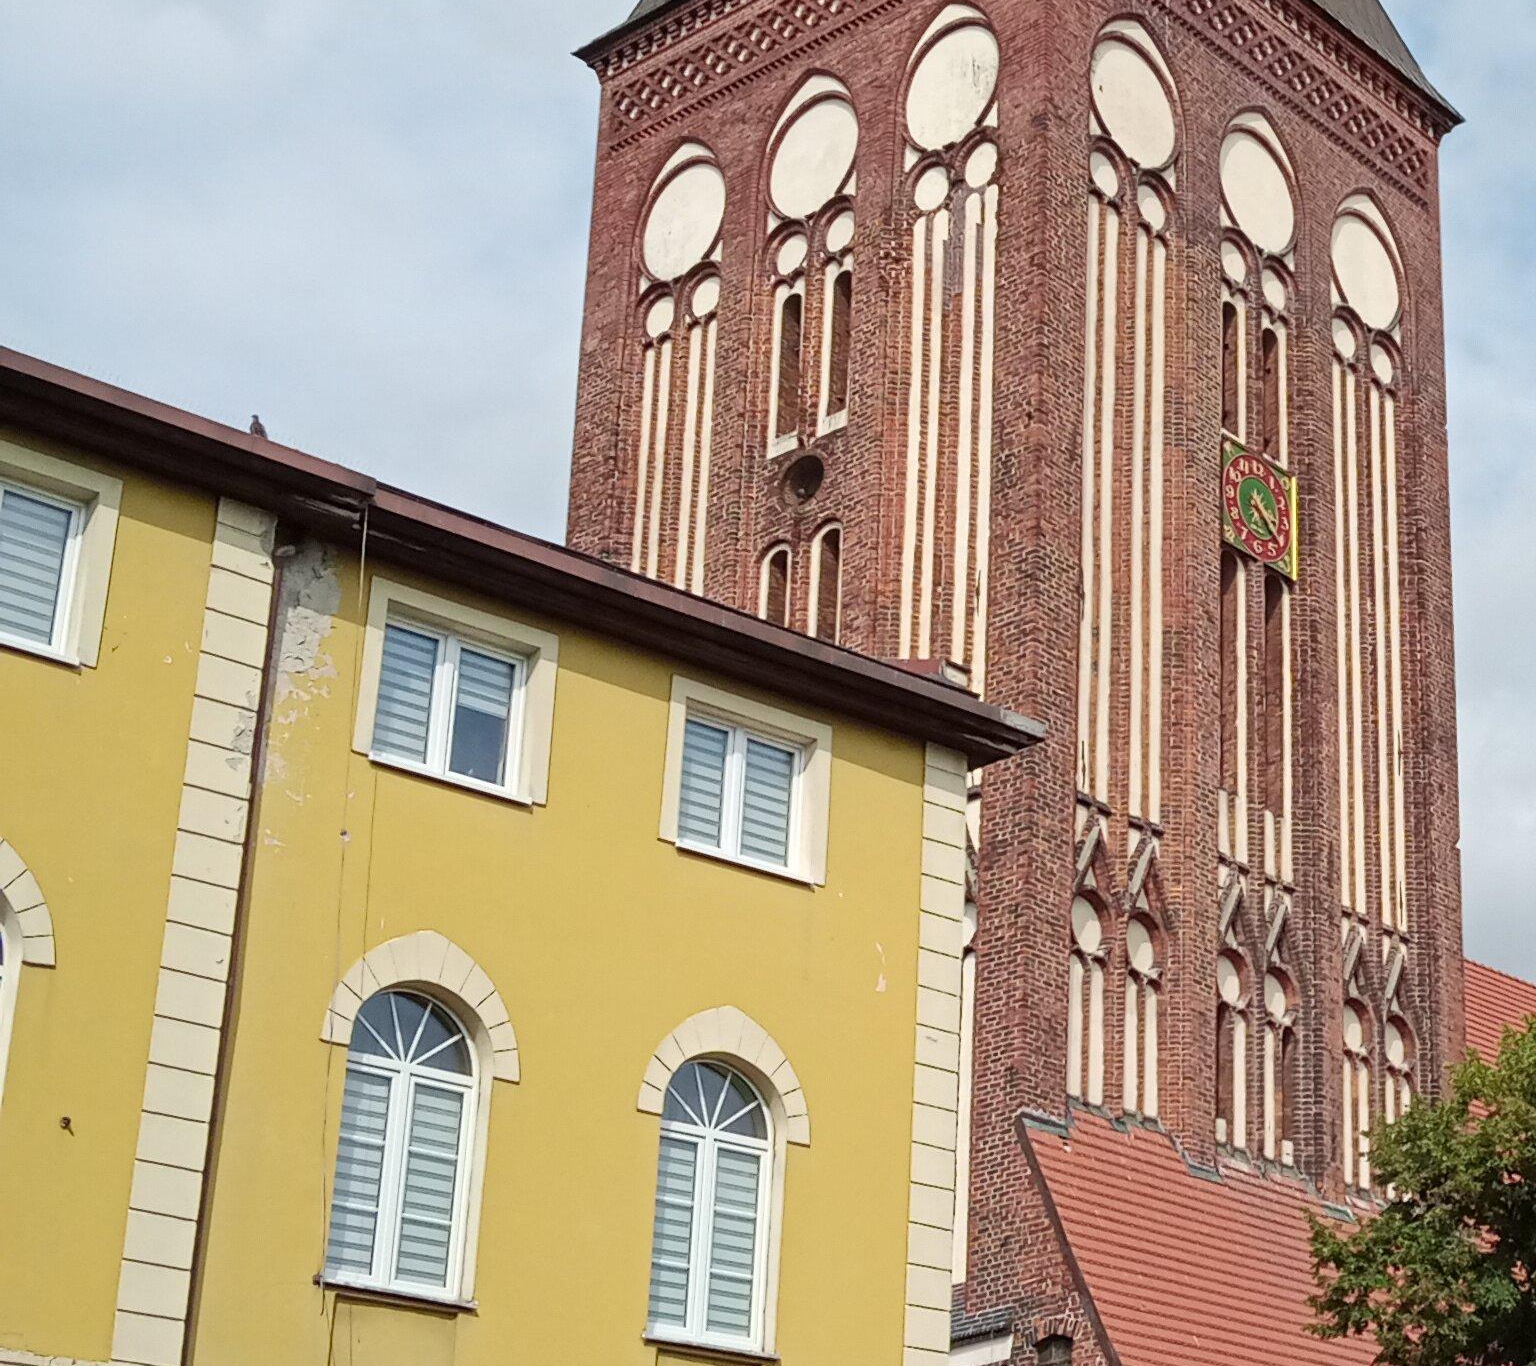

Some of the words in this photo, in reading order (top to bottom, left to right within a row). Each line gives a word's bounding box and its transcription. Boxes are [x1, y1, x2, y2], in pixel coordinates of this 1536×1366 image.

[1239, 457, 1249, 475] 11
[1251, 459, 1265, 477] 12
[1229, 466, 1241, 483] 10
[1269, 475, 1275, 490] 1
[1225, 484, 1235, 499] 9
[1277, 496, 1287, 510] 2
[1230, 506, 1240, 520] 8
[1280, 516, 1289, 531] 3
[1240, 525, 1249, 540] 7
[1253, 539, 1263, 554] 6
[1267, 541, 1279, 557] 5
